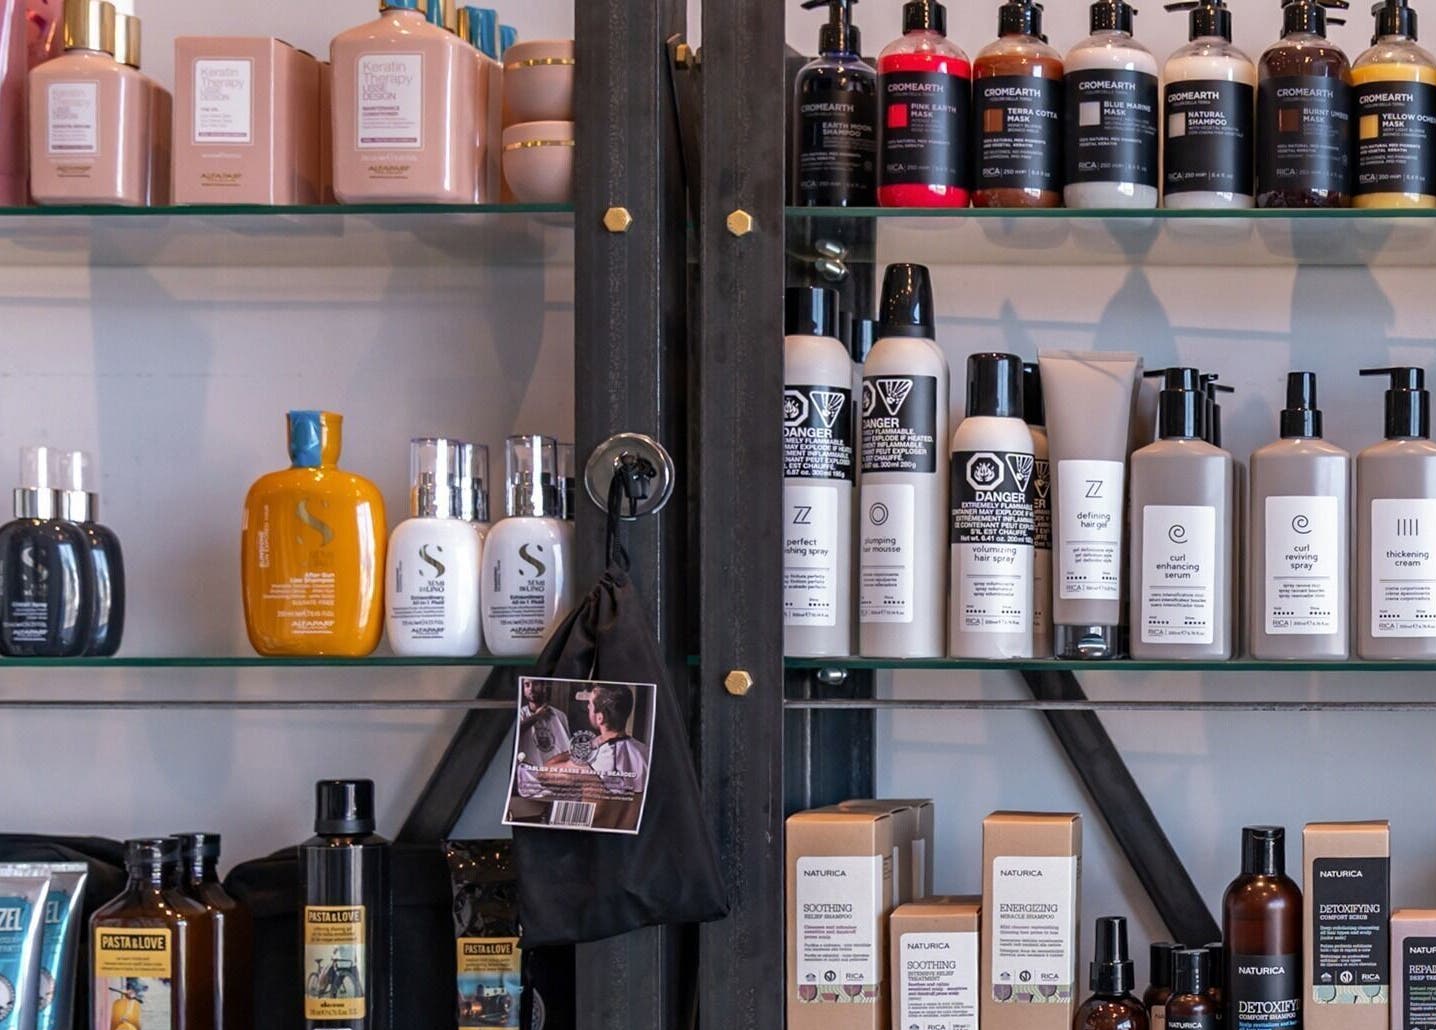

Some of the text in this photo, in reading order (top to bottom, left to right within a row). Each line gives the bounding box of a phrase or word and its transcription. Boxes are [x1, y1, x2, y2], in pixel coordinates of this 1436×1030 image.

[363, 61, 407, 74] Keratin
[888, 83, 944, 92] CROMEARTH
[1079, 81, 1135, 91] CROMEARTH
[984, 88, 1040, 98] CROMEARTH
[1169, 91, 1219, 102] CROMEARTH
[1277, 88, 1333, 98] CROMEARTH
[1359, 93, 1413, 103] CROMEARTH
[911, 103, 930, 111] PINK
[1104, 101, 1123, 109] BLUE
[1007, 108, 1058, 119] TERRA COTTA
[1188, 112, 1225, 120] NATURAL
[1382, 113, 1415, 122] YELLOW
[1007, 115, 1030, 123] MASK
[1188, 118, 1227, 127] SHAMPOO
[1383, 120, 1405, 128] MASK
[976, 491, 1025, 502] DANGER
[1077, 512, 1110, 521] defining
[787, 539, 817, 547] perfect
[973, 545, 1016, 556] volumizing
[1294, 544, 1310, 552] curl
[974, 554, 1014, 564] hair spray
[1285, 553, 1318, 561] reviving
[1387, 549, 1429, 561] thickening
[1156, 562, 1199, 572] enhancing
[1291, 561, 1313, 570] spray
[804, 904, 852, 913] SOOTHING
[1000, 904, 1057, 913] ENERGIZING
[1320, 904, 1380, 913] DETOXIFYING
[307, 911, 360, 922] PASTA&LOVE
[101, 934, 164, 950] PASTA&LOVE
[907, 961, 955, 970] SOOTHING
